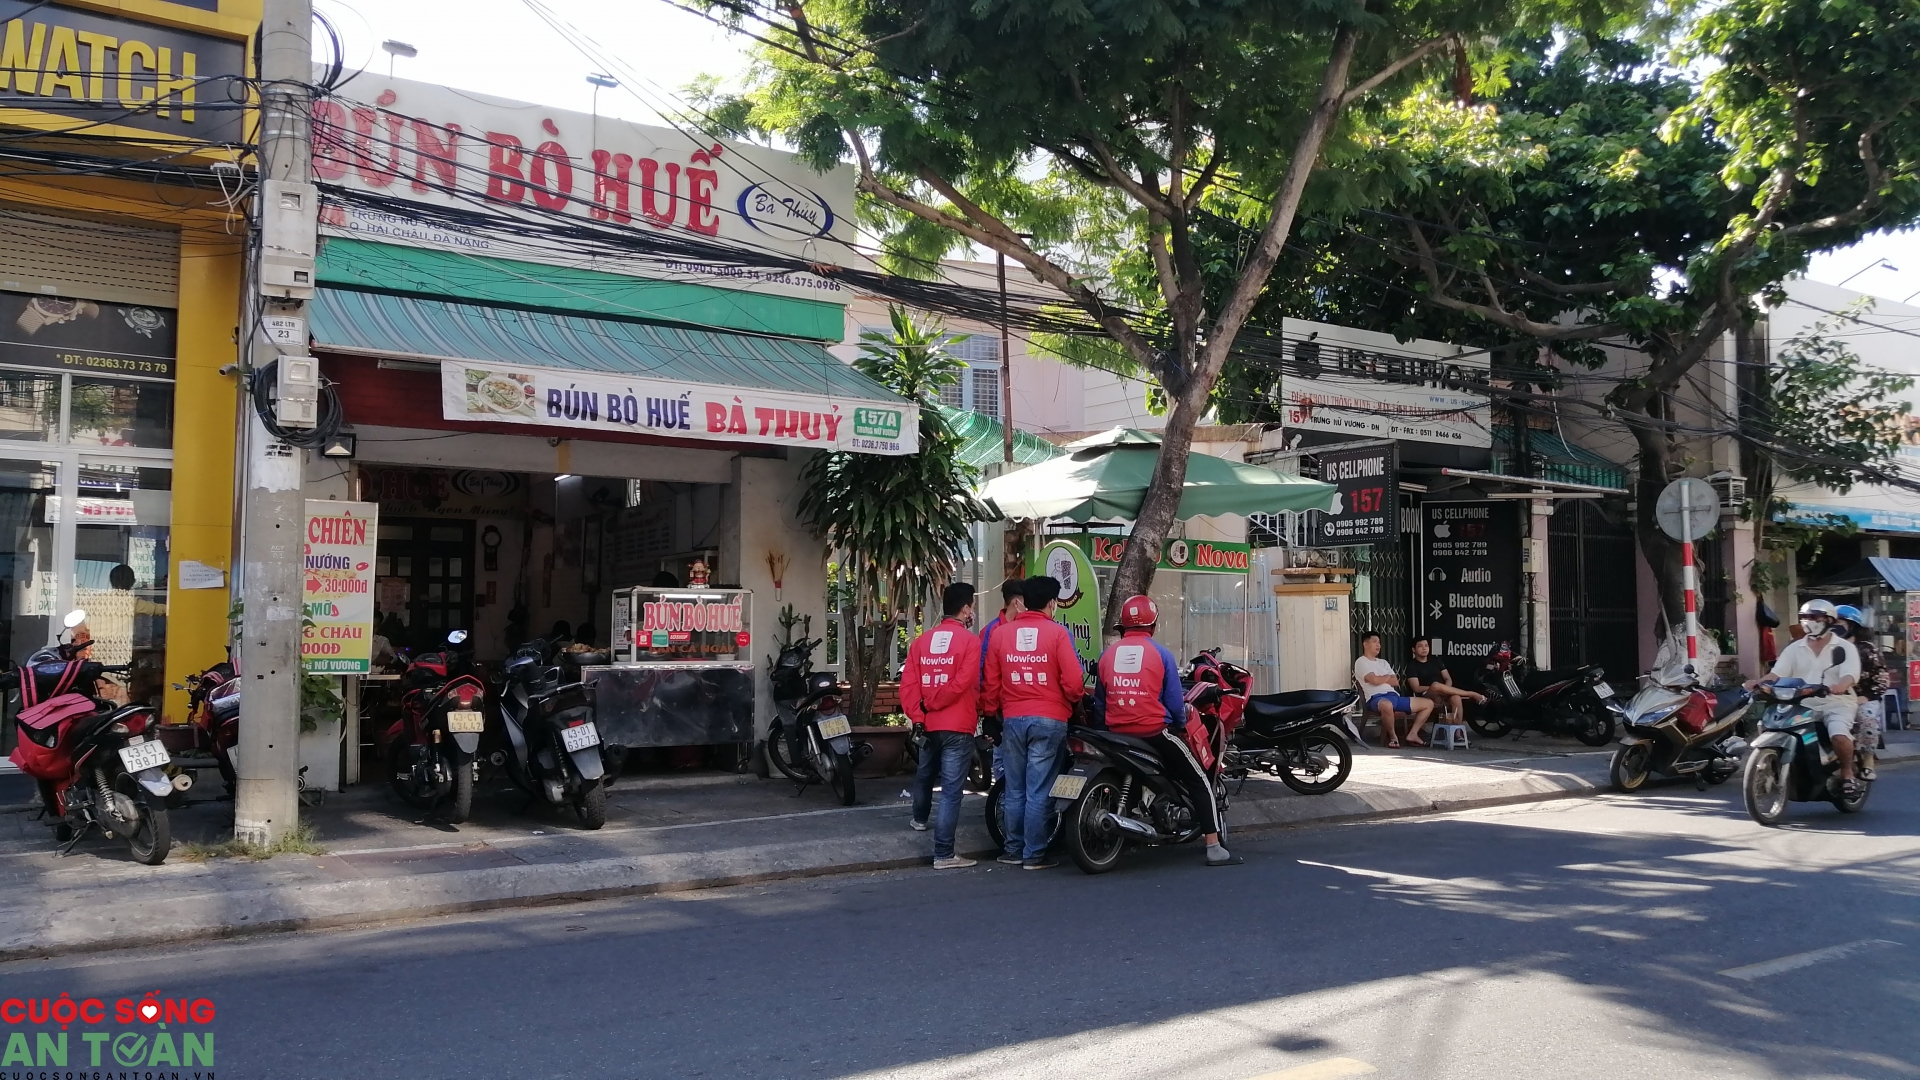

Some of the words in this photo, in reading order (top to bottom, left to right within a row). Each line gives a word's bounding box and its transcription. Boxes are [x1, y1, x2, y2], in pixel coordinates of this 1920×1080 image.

[0, 18, 196, 122] WATCH
[485, 118, 573, 212] BÒ
[589, 143, 723, 237] HUẾ
[278, 330, 290, 339] 23
[138, 360, 152, 371] 73
[154, 362, 168, 373] 79
[547, 383, 599, 421] BÚN
[607, 387, 638, 426] BÒ
[647, 390, 691, 430] HUẾ
[705, 395, 748, 435] BÀ
[859, 410, 897, 427] 157A
[1326, 462, 1337, 481] US
[1339, 456, 1385, 479] CELLPHONE
[1350, 487, 1384, 513] 157
[1432, 508, 1443, 519] US
[1445, 507, 1490, 519] CELLPHONE
[308, 510, 367, 546] CHIÊN
[1336, 519, 1353, 527] 0905
[1355, 518, 1369, 527] 992
[1370, 517, 1384, 525] 789
[1370, 525, 1384, 534] 789
[306, 553, 350, 570] NƯỚNG
[1194, 543, 1249, 569] Nova
[1461, 567, 1492, 582] Audio
[1326, 598, 1337, 608] 157
[1448, 593, 1503, 608] Bluetooth
[643, 595, 681, 632] BÚN
[682, 595, 707, 632] BÒ
[706, 593, 743, 632] HUẾ
[1456, 613, 1496, 630] Device
[320, 625, 363, 639] CHÂU
[330, 661, 361, 670] VƯƠNG
[1113, 675, 1141, 688] Now
[453, 713, 477, 722] 43-C1
[451, 722, 482, 731] 434.42
[567, 735, 598, 750] 632.73
[127, 743, 158, 759] 43-C1
[127, 752, 167, 771] 798.72
